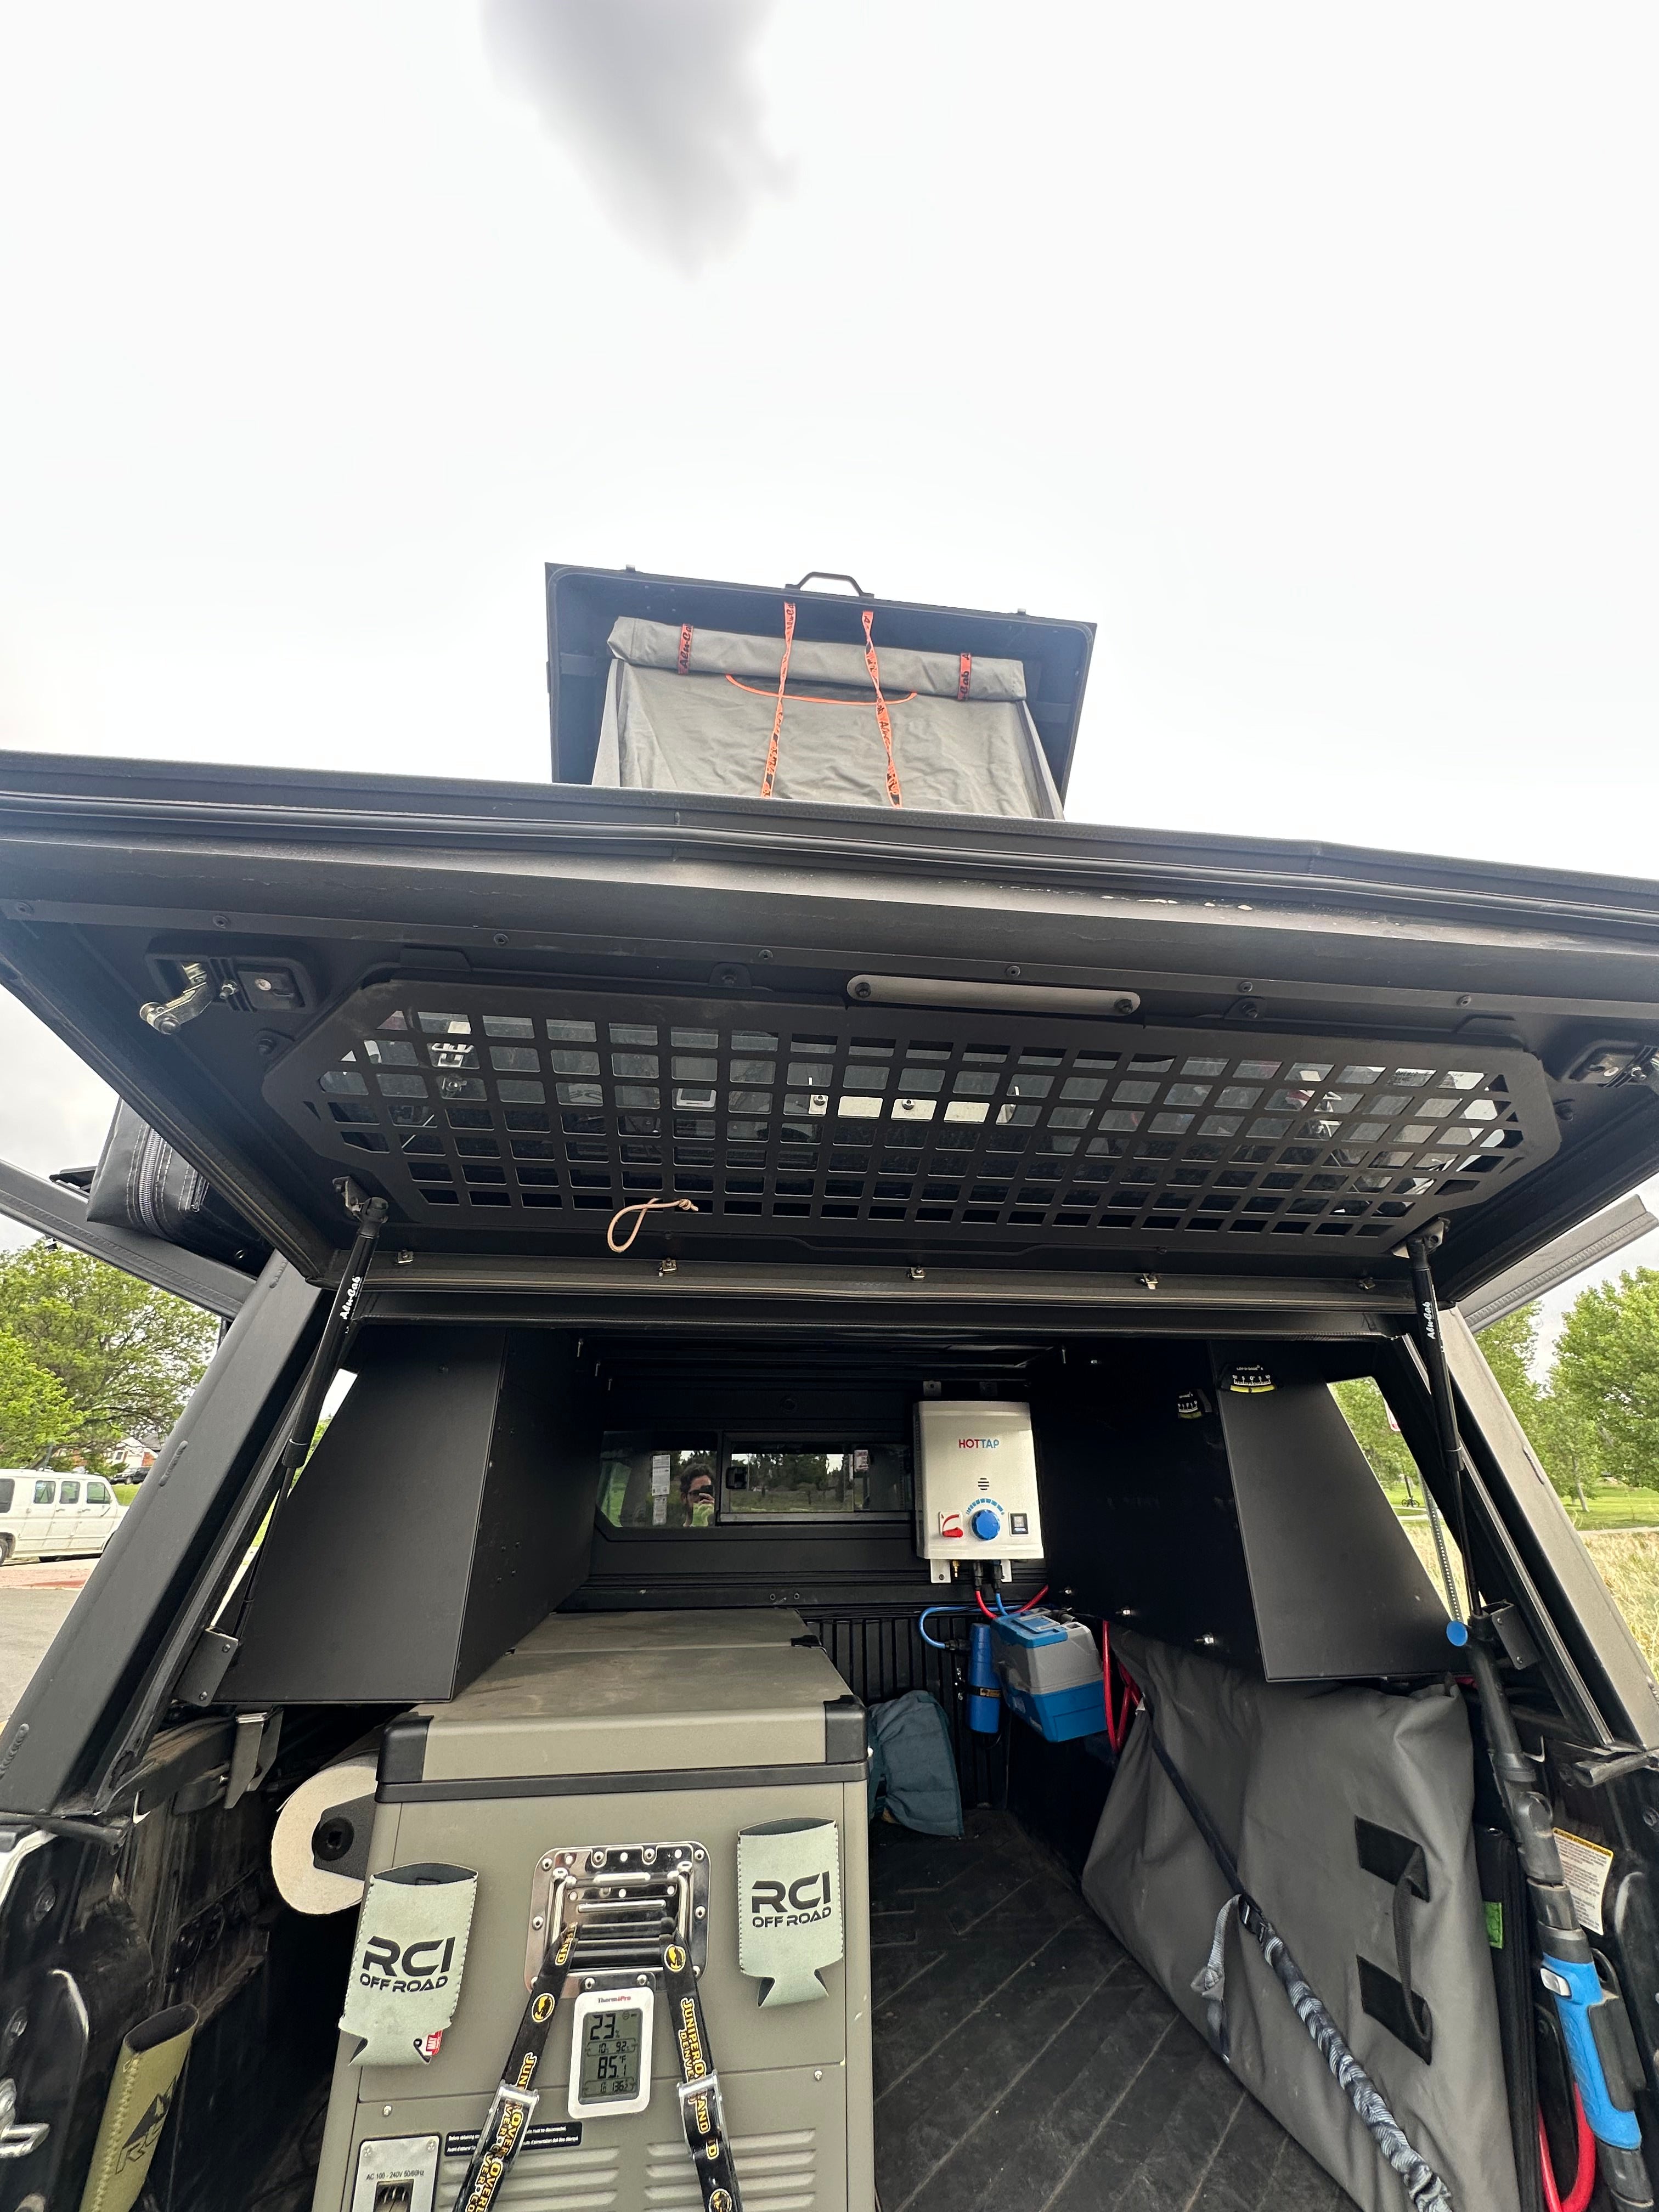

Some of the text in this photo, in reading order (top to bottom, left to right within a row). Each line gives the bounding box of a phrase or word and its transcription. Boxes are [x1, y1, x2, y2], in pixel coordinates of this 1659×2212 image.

[340, 1276, 361, 1319] Alu-Cab
[1422, 1301, 1436, 1339] Alu-Cab
[958, 1438, 994, 1448] HOTTAP
[752, 1871, 831, 1913] RCI
[752, 1906, 831, 1928] OFF ROAD
[362, 1936, 455, 1977] RCI
[360, 1973, 448, 1993] OFF ROAD
[682, 1999, 701, 2062] JUNIPER
